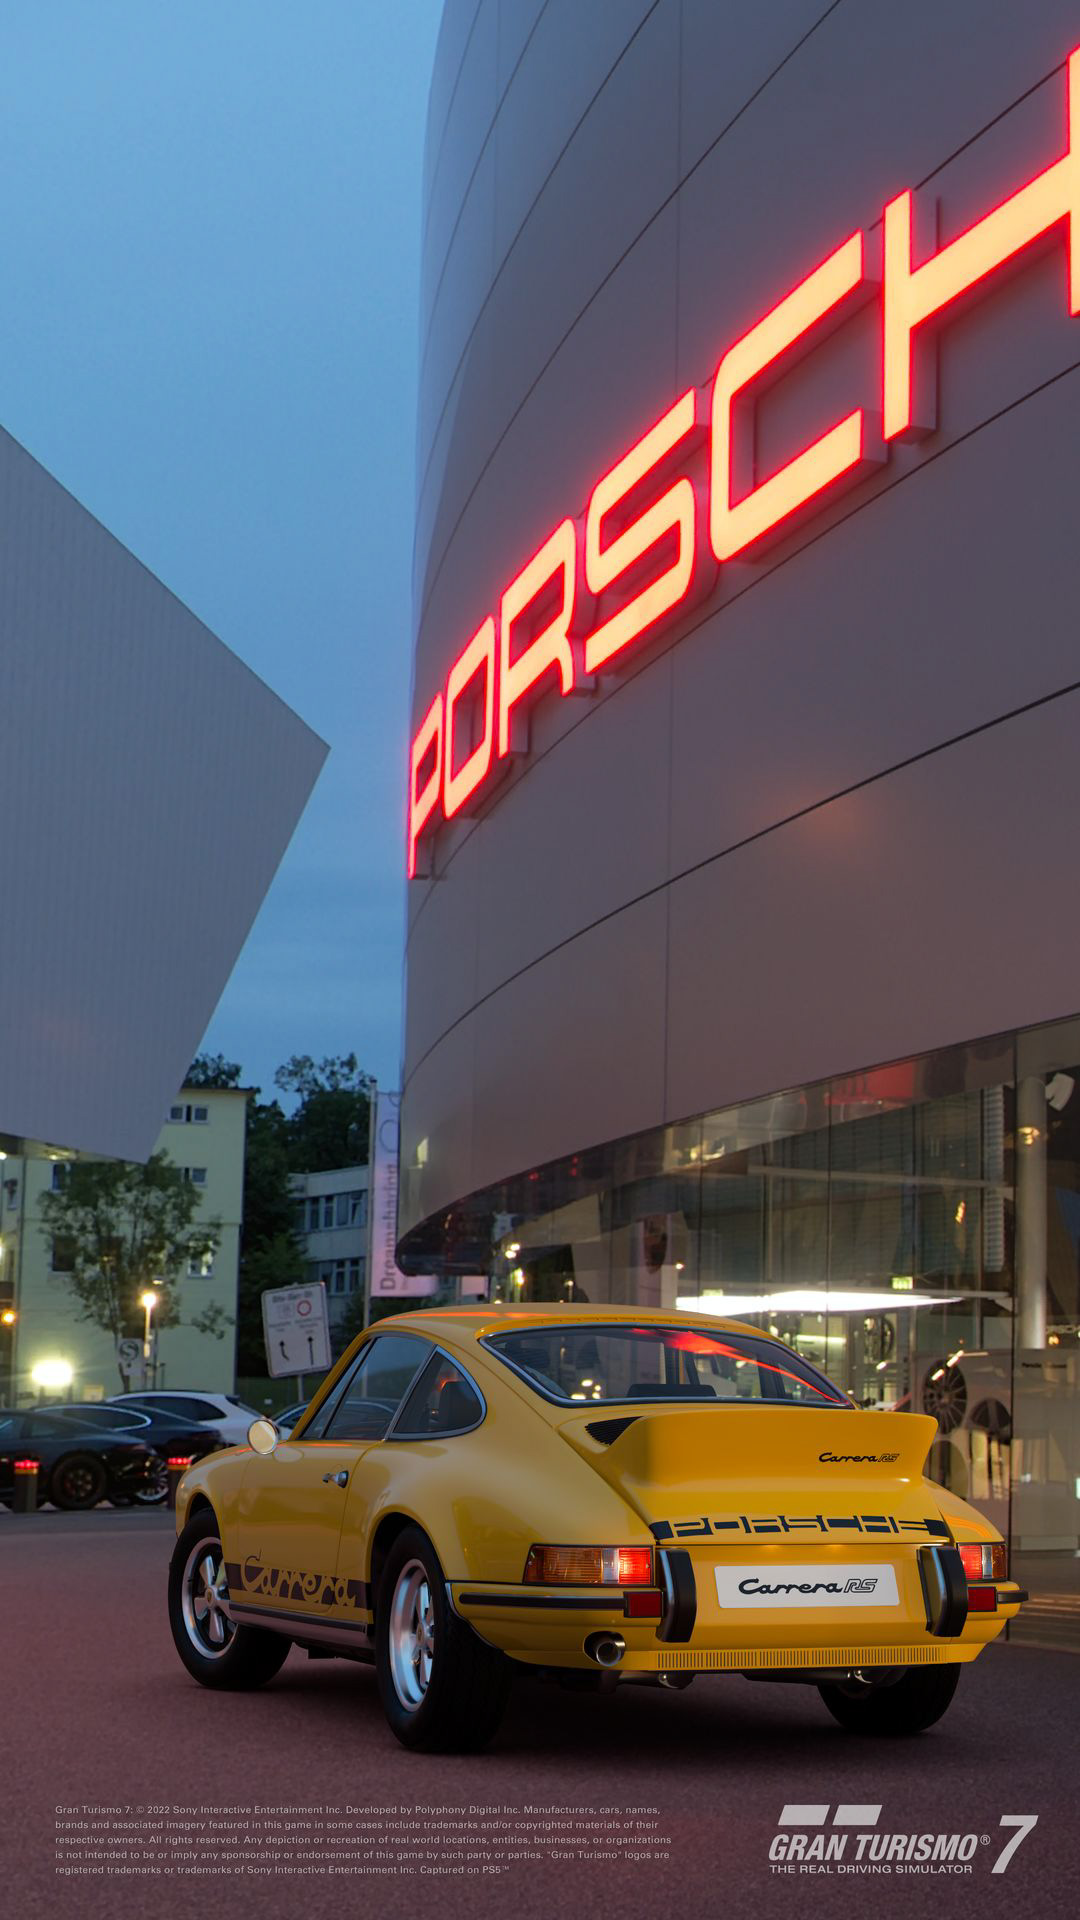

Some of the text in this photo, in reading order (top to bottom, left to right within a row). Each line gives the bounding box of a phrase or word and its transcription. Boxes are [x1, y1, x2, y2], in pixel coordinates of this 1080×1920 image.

[819, 1452, 900, 1463] Carrera RS
[240, 1548, 357, 1607] Carrera
[738, 1577, 878, 1595] Carrera RS
